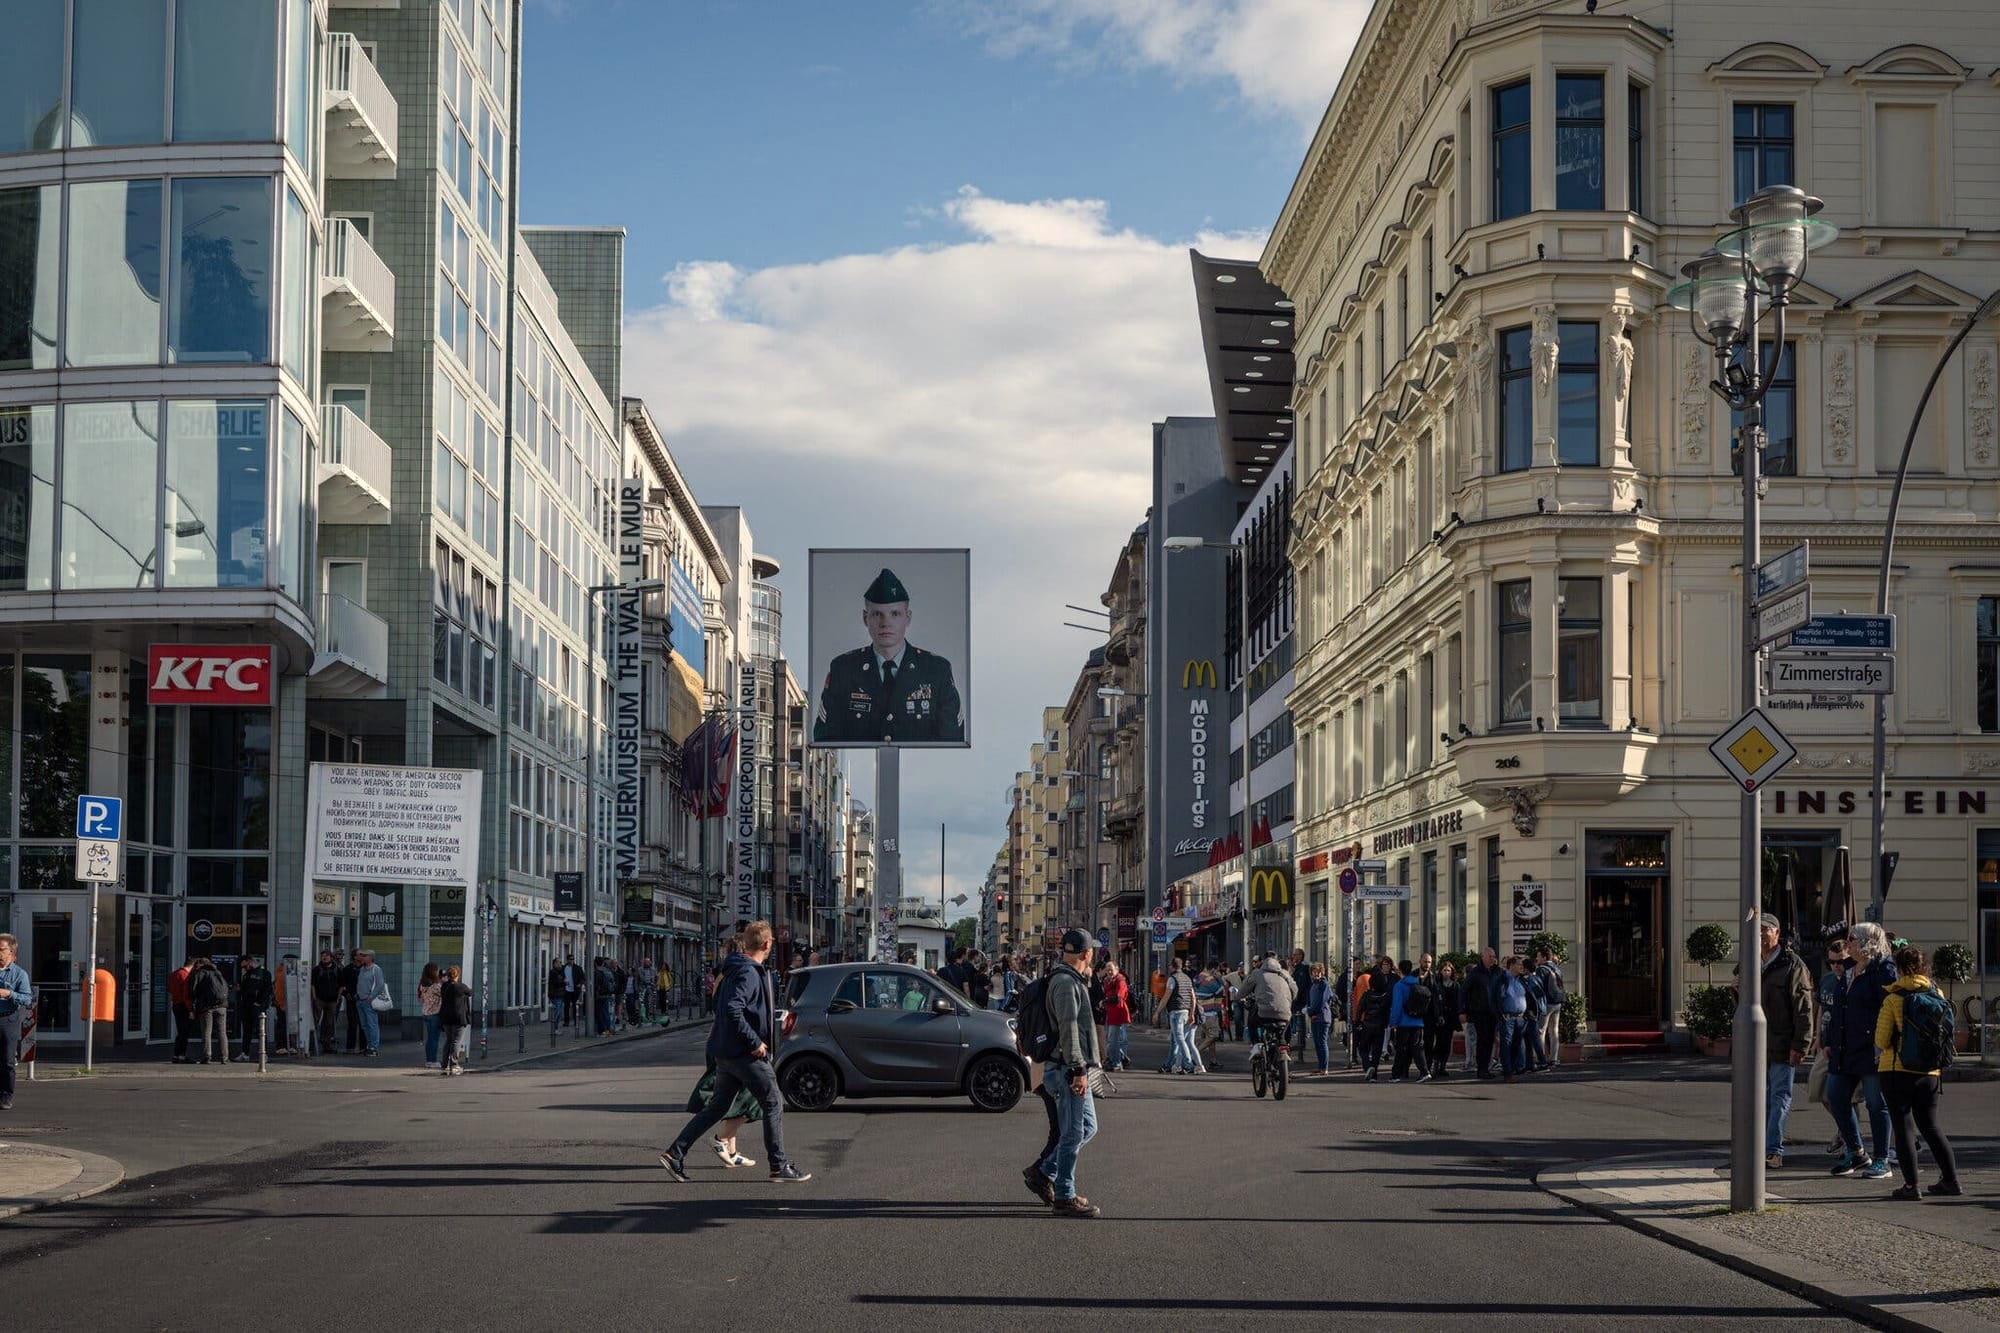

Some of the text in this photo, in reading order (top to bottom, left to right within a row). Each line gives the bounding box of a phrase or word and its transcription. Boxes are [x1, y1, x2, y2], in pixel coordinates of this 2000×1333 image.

[179, 410, 262, 436] CHARLIE
[621, 487, 641, 538] MUR
[620, 544, 639, 565] LE
[1845, 629, 1864, 637] Reality
[618, 643, 638, 680] THE
[151, 657, 265, 692] KFC
[1780, 664, 1882, 685] Zimmerstraße
[1190, 700, 1210, 828] McDonald's
[1496, 756, 1520, 769] 206
[330, 777, 461, 790] CARRYING WEAPONS OFF DUTY FORBIDDEN
[331, 768, 345, 776] YOU
[346, 768, 358, 776] ARE
[361, 769, 390, 778] ENTERING
[405, 771, 437, 780] AMERICAN
[439, 772, 463, 781] SECTOR
[617, 692, 639, 870] MAUERMUSEUM
[363, 787, 428, 798] OBEY TRAFFIC RULES
[740, 738, 754, 837] CHECKPOINT
[1761, 790, 1987, 814] INSEIN
[85, 801, 108, 833] P
[325, 832, 342, 840] VOUS
[345, 832, 366, 841] ENTREZ
[369, 833, 386, 842] DANS
[388, 834, 393, 842] LE
[396, 835, 423, 843] SECTEUR
[1373, 809, 1463, 855] EINSTEIN KAFFEE
[353, 841, 373, 849] PORTER
[439, 845, 460, 854] SERVICE
[740, 842, 753, 868] AM
[1174, 837, 1217, 854] McCaf
[364, 850, 376, 858] AUX
[403, 852, 410, 860] DE
[413, 853, 452, 862] CIRCULATION
[323, 863, 458, 877] SIE BETRETEN DEN AMERIKANISCHEN SEKTOR
[447, 889, 464, 899] OF
[738, 873, 752, 915] HAUS
[214, 926, 240, 935] CASH
[368, 922, 395, 930] MUSEUM
[1821, 920, 1848, 936] EINST
